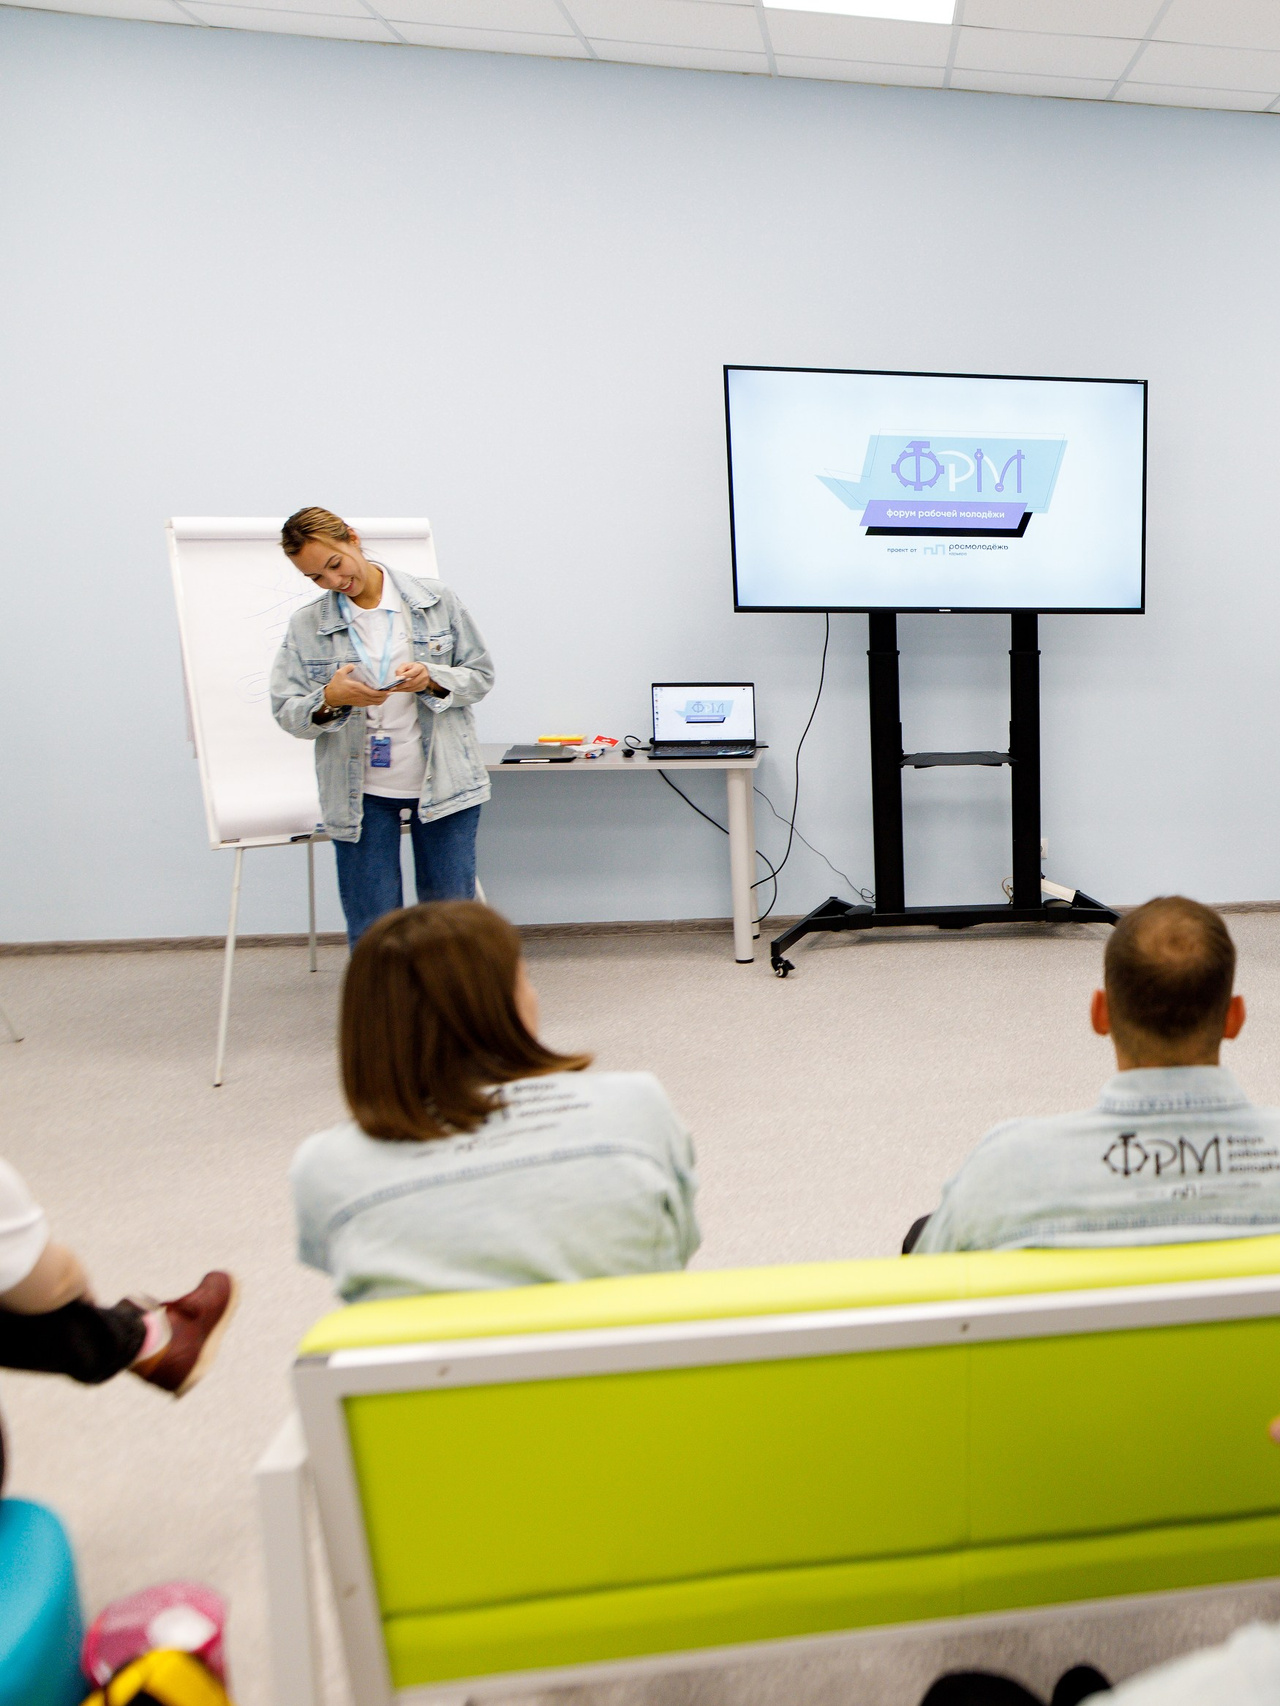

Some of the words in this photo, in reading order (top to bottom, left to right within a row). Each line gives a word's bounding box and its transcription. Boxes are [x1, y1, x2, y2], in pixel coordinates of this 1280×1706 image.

[891, 441, 1026, 494] ФРМ
[886, 508, 916, 519] форум
[918, 509, 958, 519] рабочей
[959, 509, 1005, 520] молодёжи
[948, 543, 1009, 552] росмолодёжь
[1102, 1132, 1222, 1177] ФРМ
